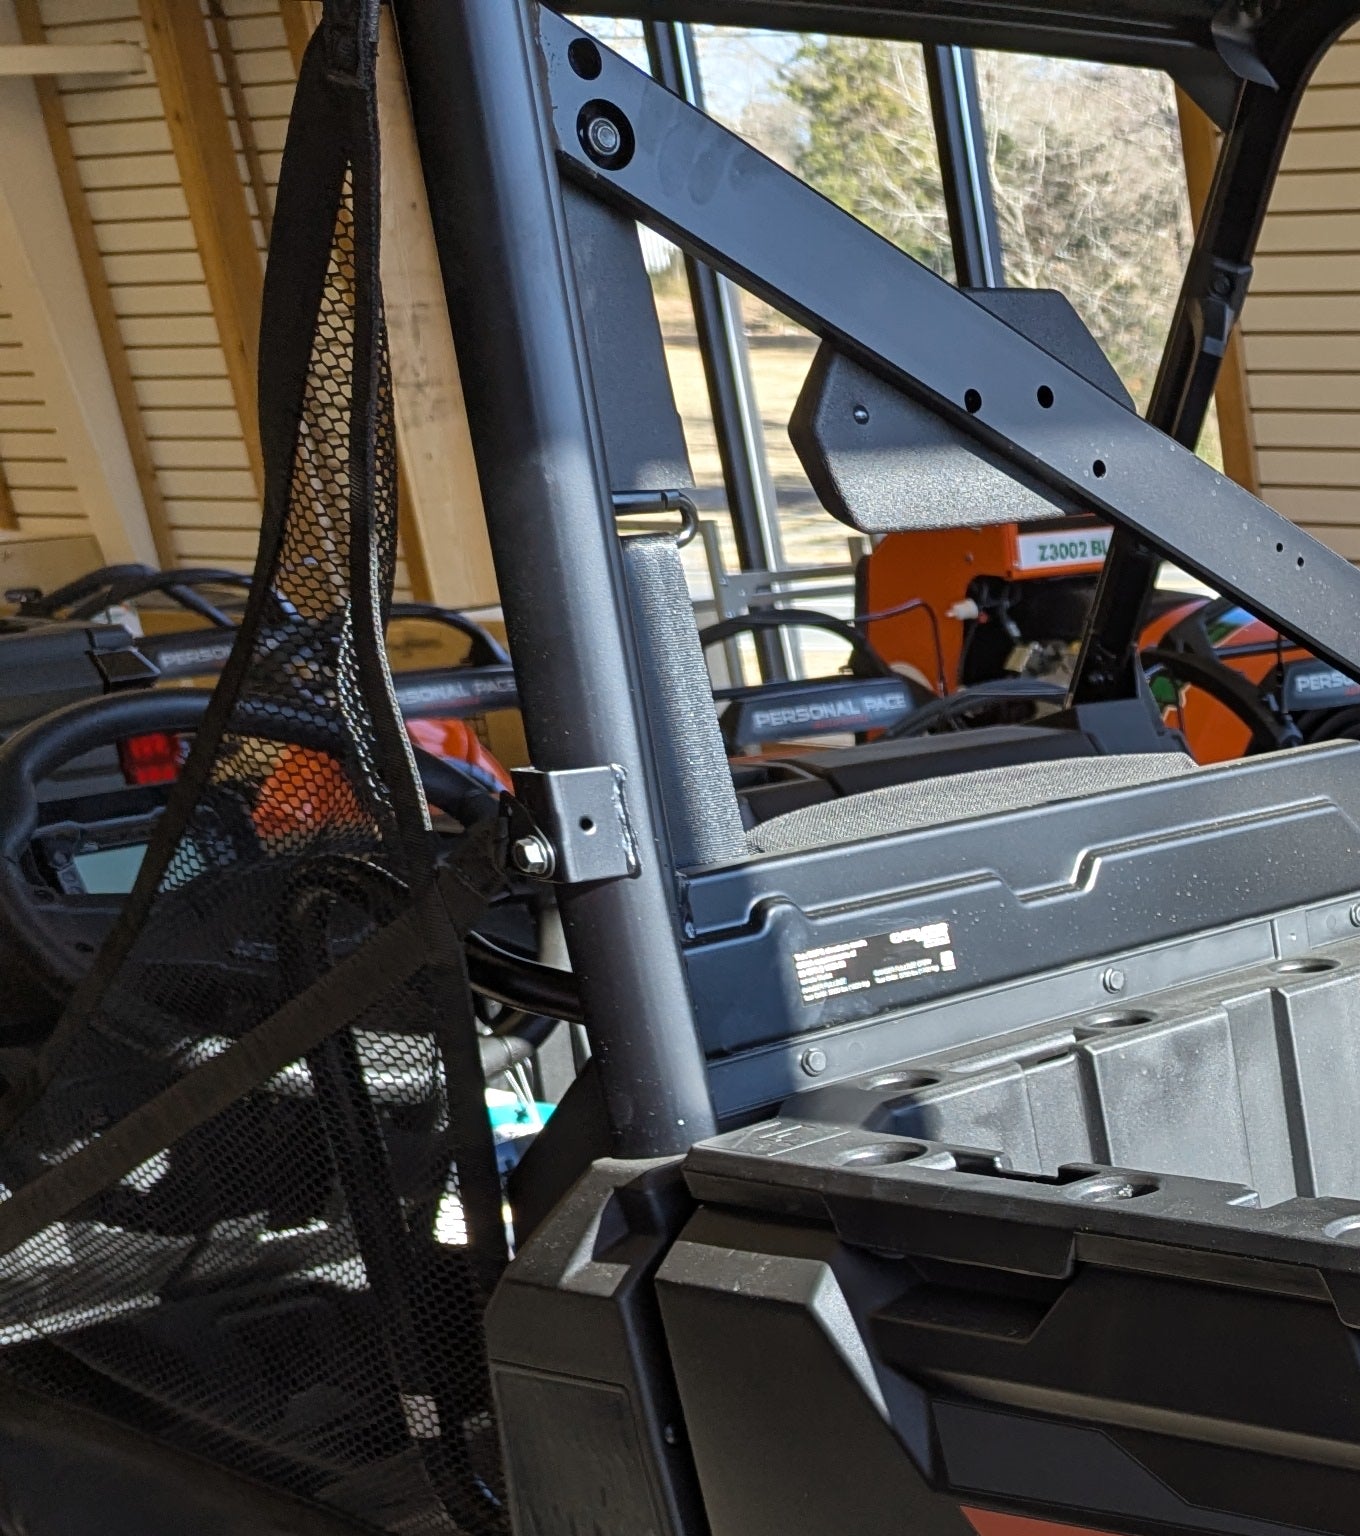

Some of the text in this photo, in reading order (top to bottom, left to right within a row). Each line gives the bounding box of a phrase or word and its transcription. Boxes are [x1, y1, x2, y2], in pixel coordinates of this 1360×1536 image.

[1038, 541, 1088, 561] Z3002
[753, 700, 862, 729] PERSONAL
[864, 692, 907, 713] PACE
